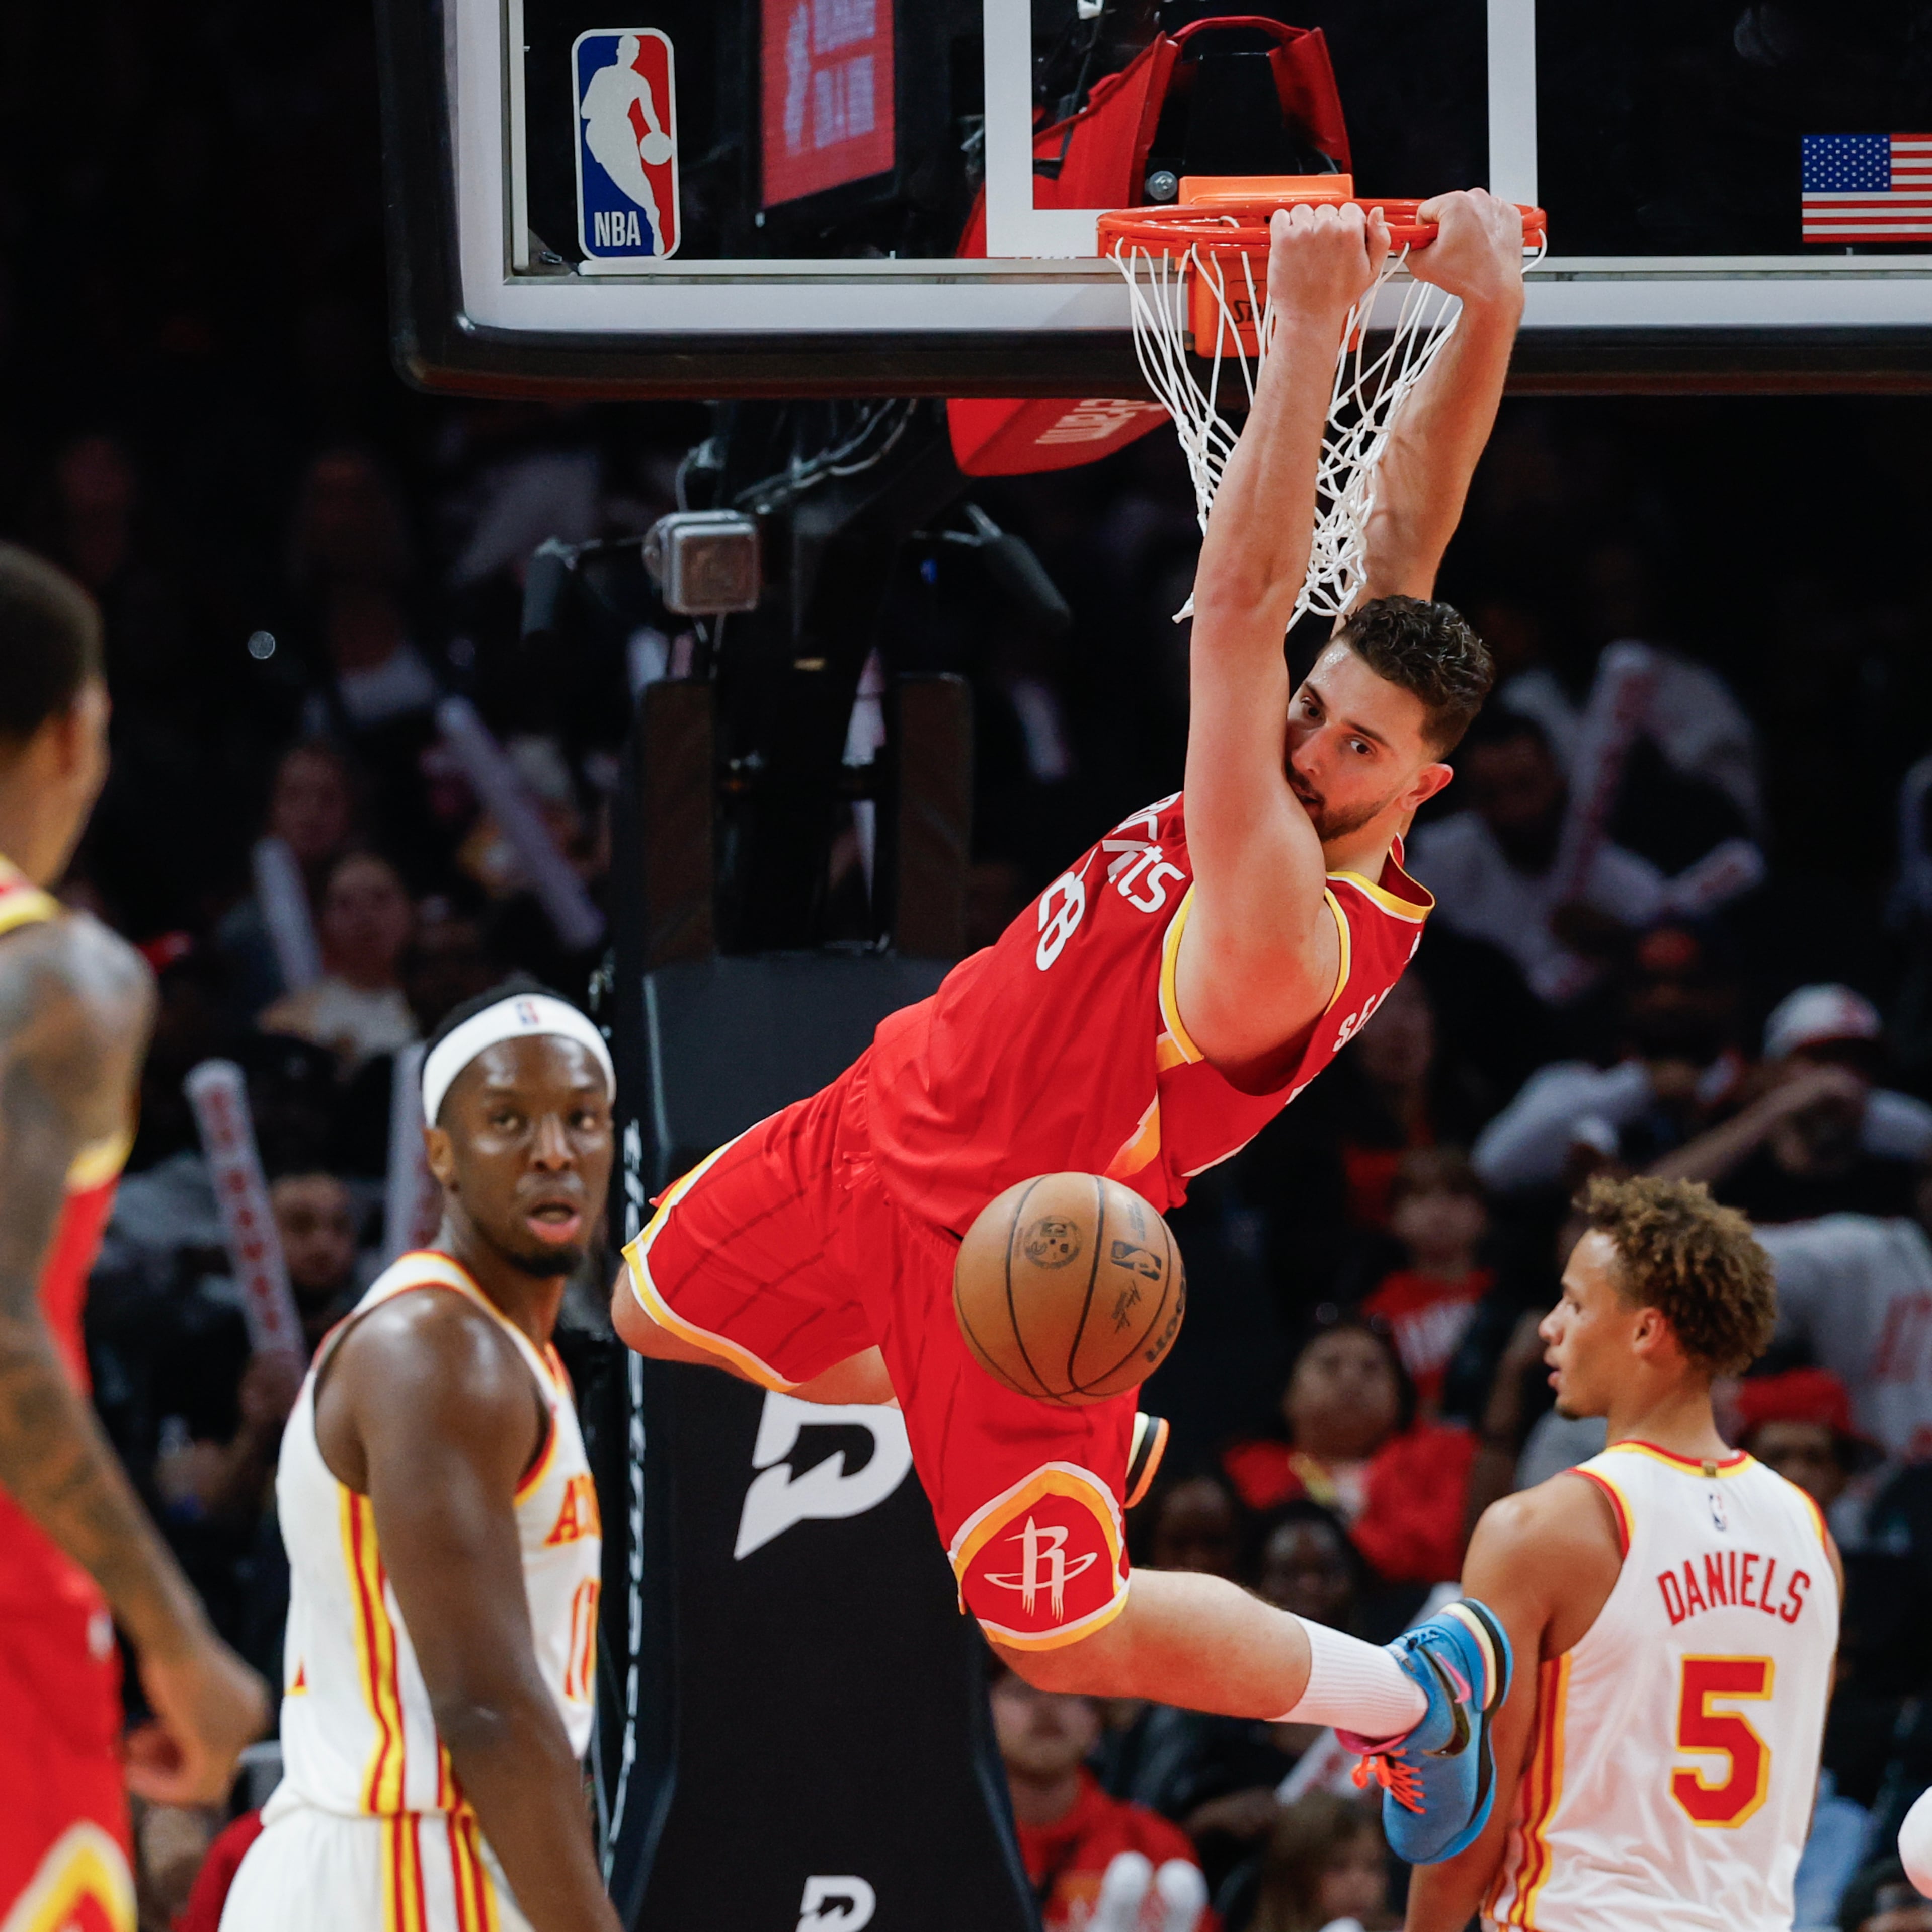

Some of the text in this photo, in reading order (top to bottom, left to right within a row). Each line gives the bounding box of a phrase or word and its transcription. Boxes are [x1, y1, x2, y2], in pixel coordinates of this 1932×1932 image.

[594, 211, 641, 247] NBA
[1657, 1550, 1811, 1627] DANIELS
[1669, 1653, 1776, 1829] 5
